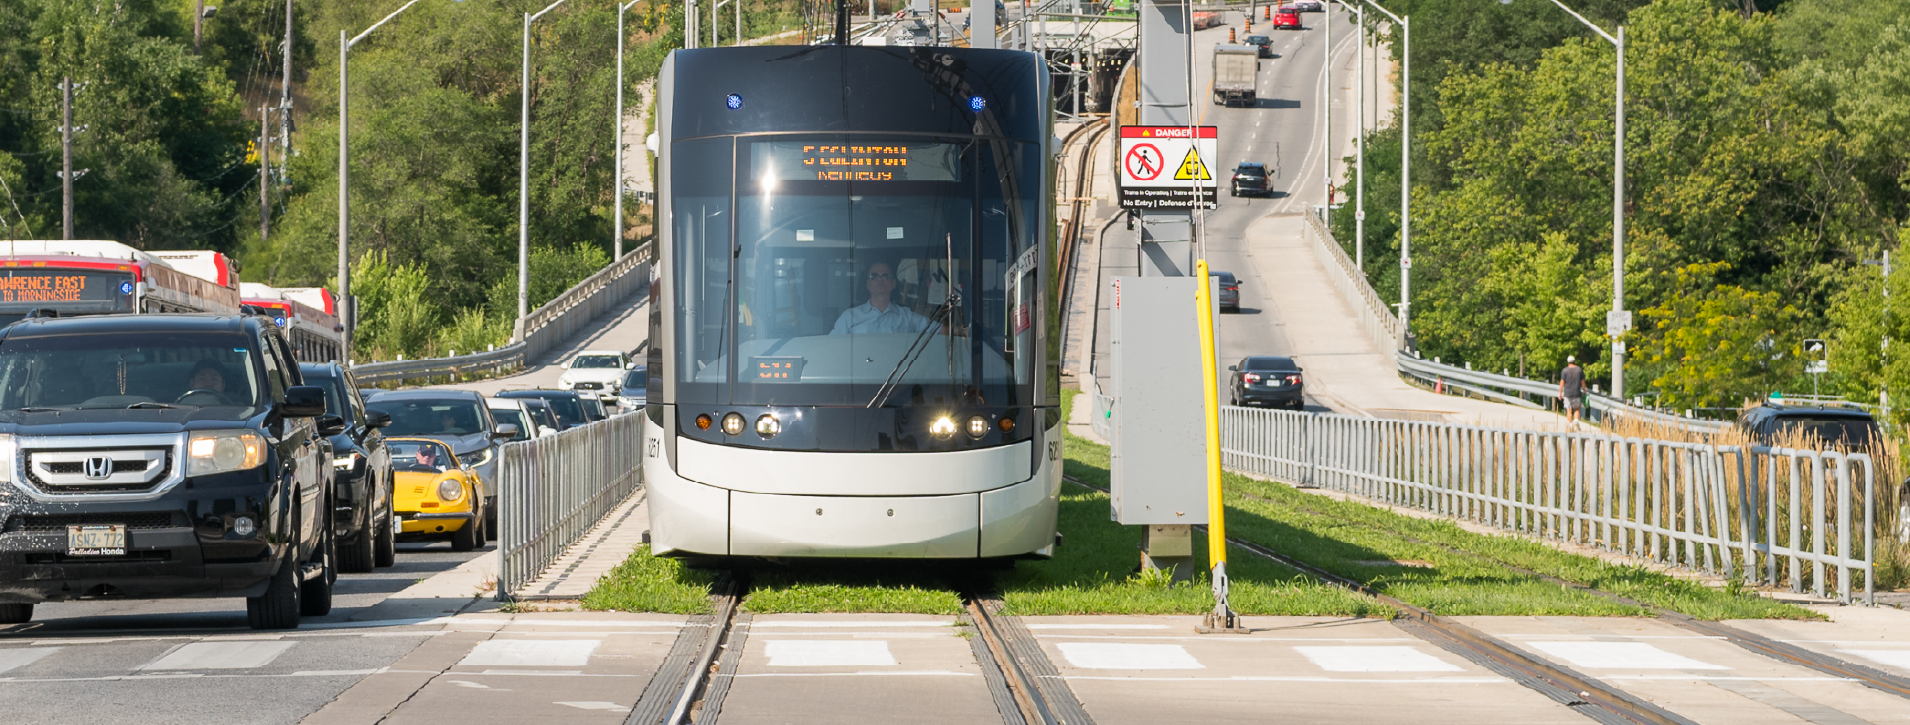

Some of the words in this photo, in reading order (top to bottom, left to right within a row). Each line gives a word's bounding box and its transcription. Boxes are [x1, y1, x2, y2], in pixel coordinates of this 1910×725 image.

[1155, 128, 1193, 137] DANGER
[803, 145, 815, 166] 5
[1134, 199, 1154, 208] Entry
[55, 276, 86, 290] EAST
[3, 290, 14, 302] TO
[18, 289, 81, 301] MORNINGSIDE
[101, 547, 124, 555] Honda
